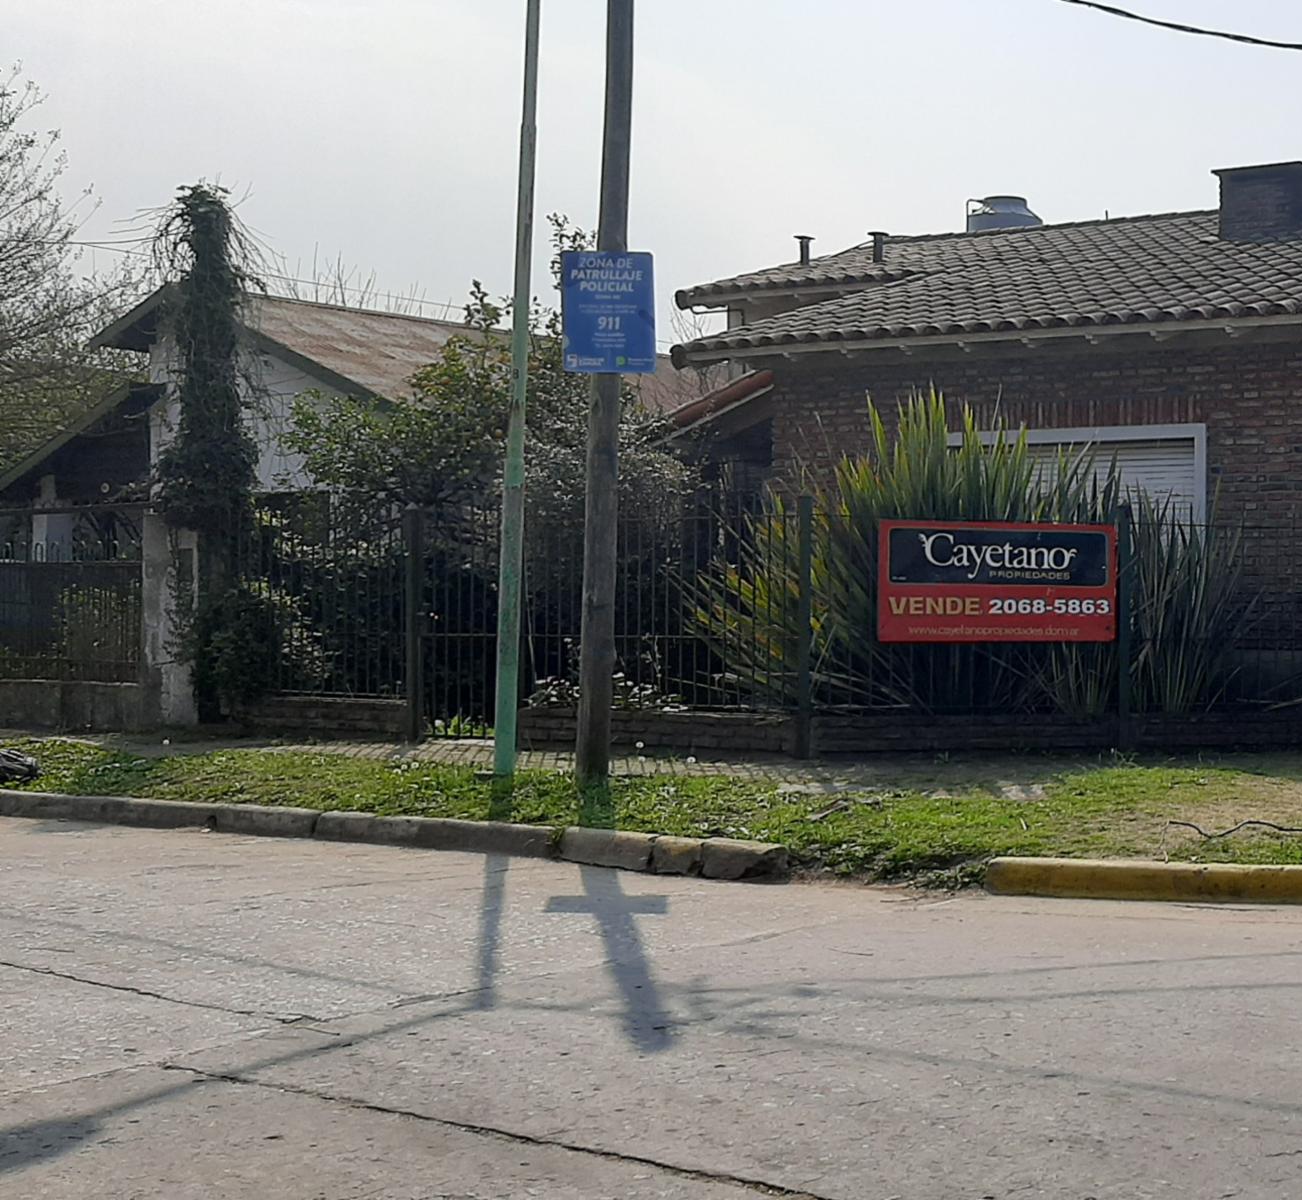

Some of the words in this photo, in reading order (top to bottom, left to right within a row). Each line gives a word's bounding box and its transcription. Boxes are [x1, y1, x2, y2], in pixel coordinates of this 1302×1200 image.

[578, 257, 614, 269] ZONA
[616, 257, 634, 269] DE
[570, 269, 644, 281] PATRULLAJE
[579, 281, 634, 292] POLICIAL
[597, 316, 620, 330] 911
[919, 532, 1077, 579] Cayetano
[988, 570, 1071, 580] PROPIEDADES
[888, 596, 981, 615] VENDE
[988, 598, 1110, 615] 2068-5863
